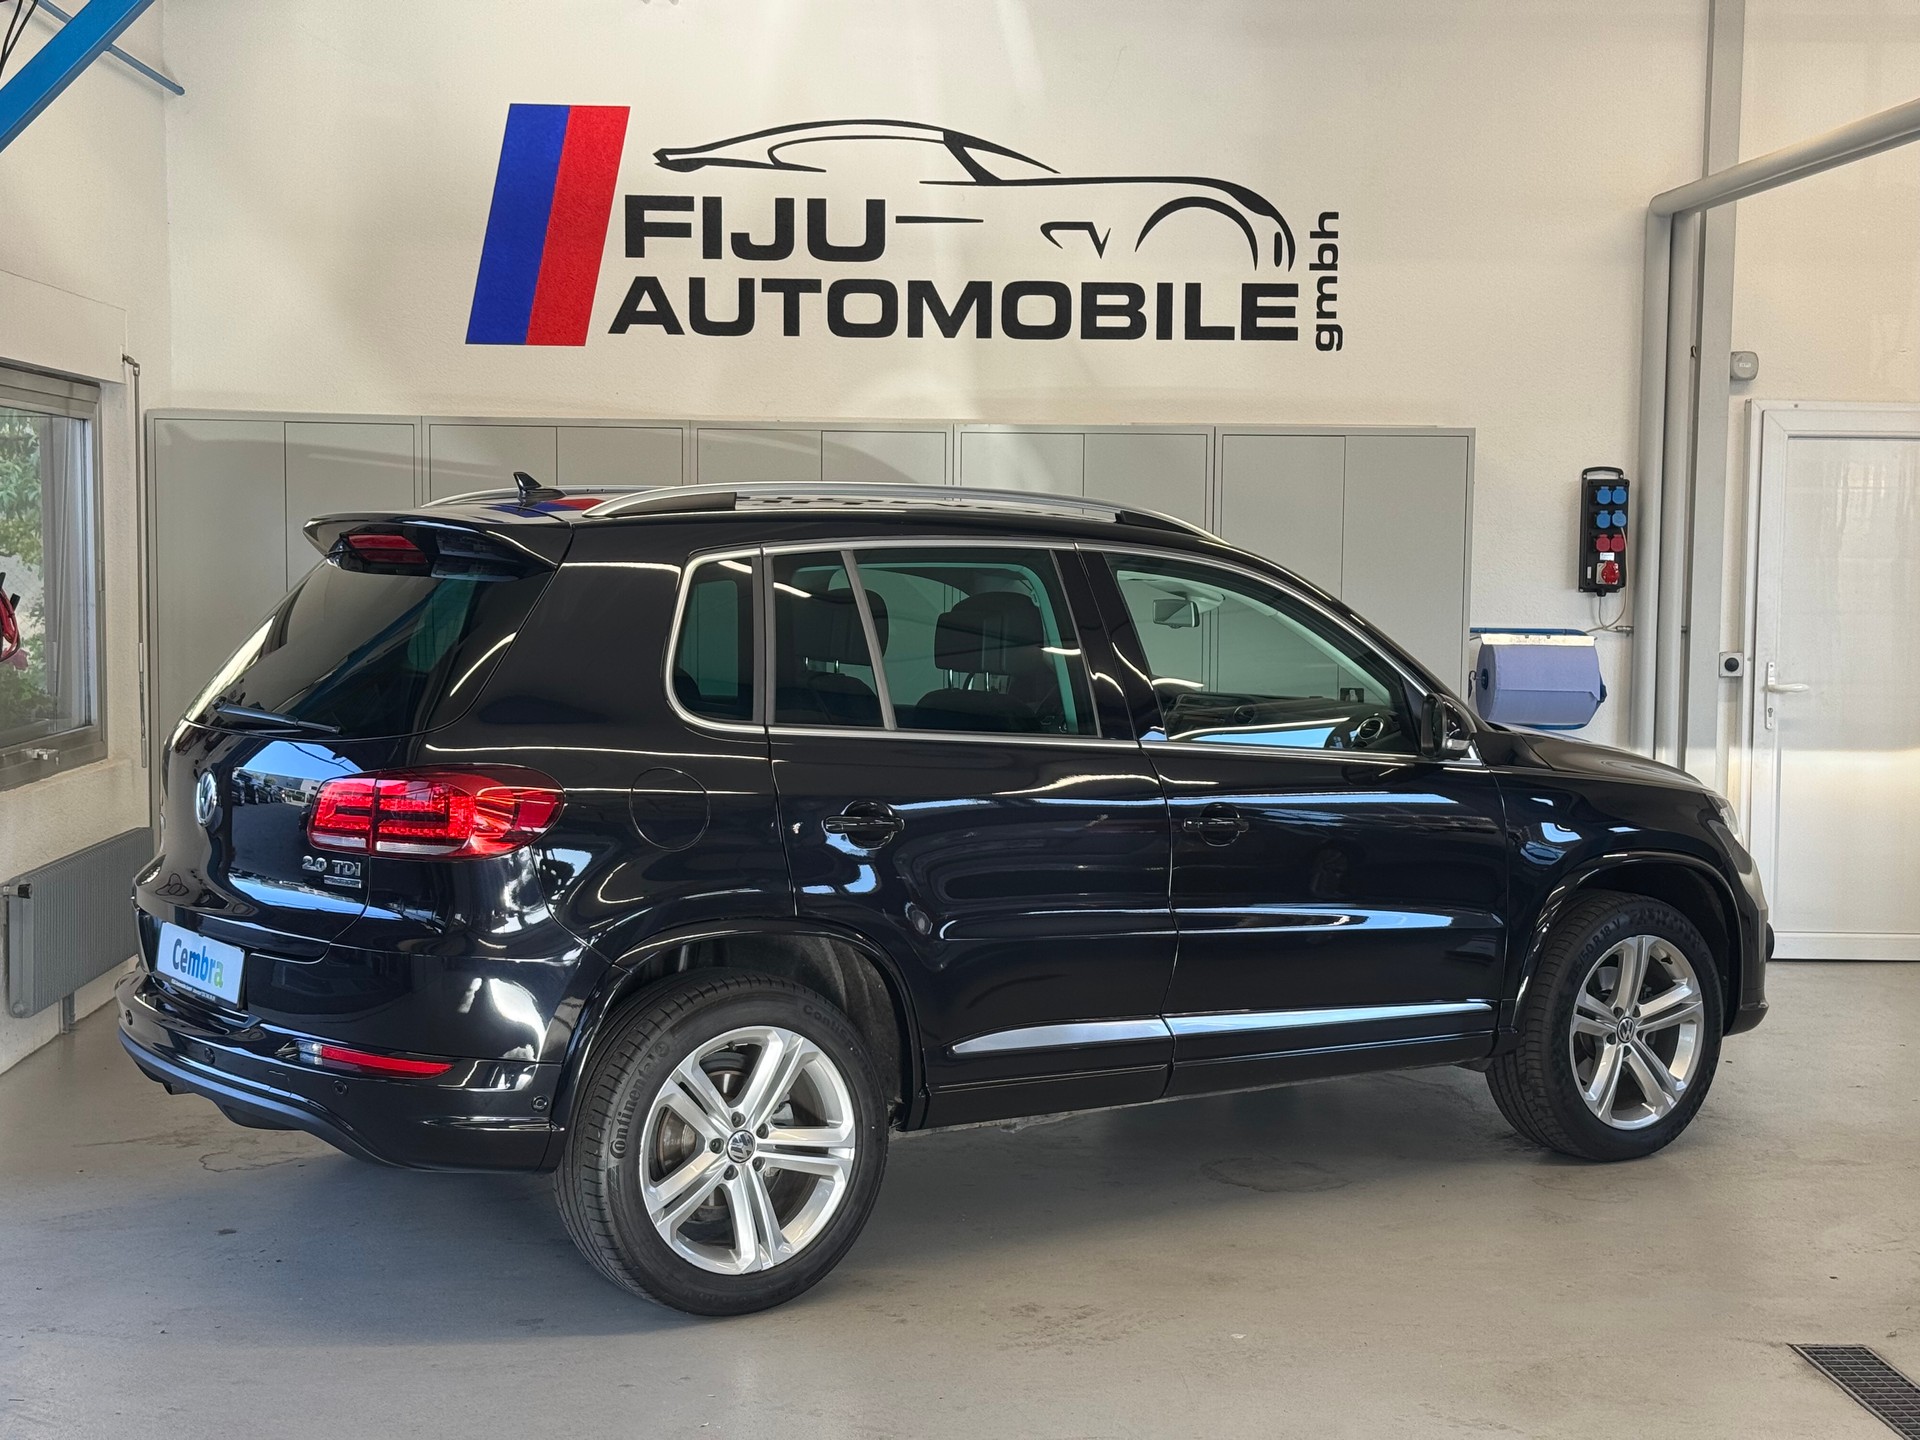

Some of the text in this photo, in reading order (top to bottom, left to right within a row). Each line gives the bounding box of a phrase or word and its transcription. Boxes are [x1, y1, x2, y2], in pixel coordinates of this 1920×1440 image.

[624, 195, 886, 262] FIJU
[608, 275, 1299, 342] AUTOMOBILE
[1309, 211, 1343, 352] gmbh
[331, 859, 361, 877] TDI
[172, 938, 224, 988] Cembra
[610, 1053, 657, 1159] Continental
